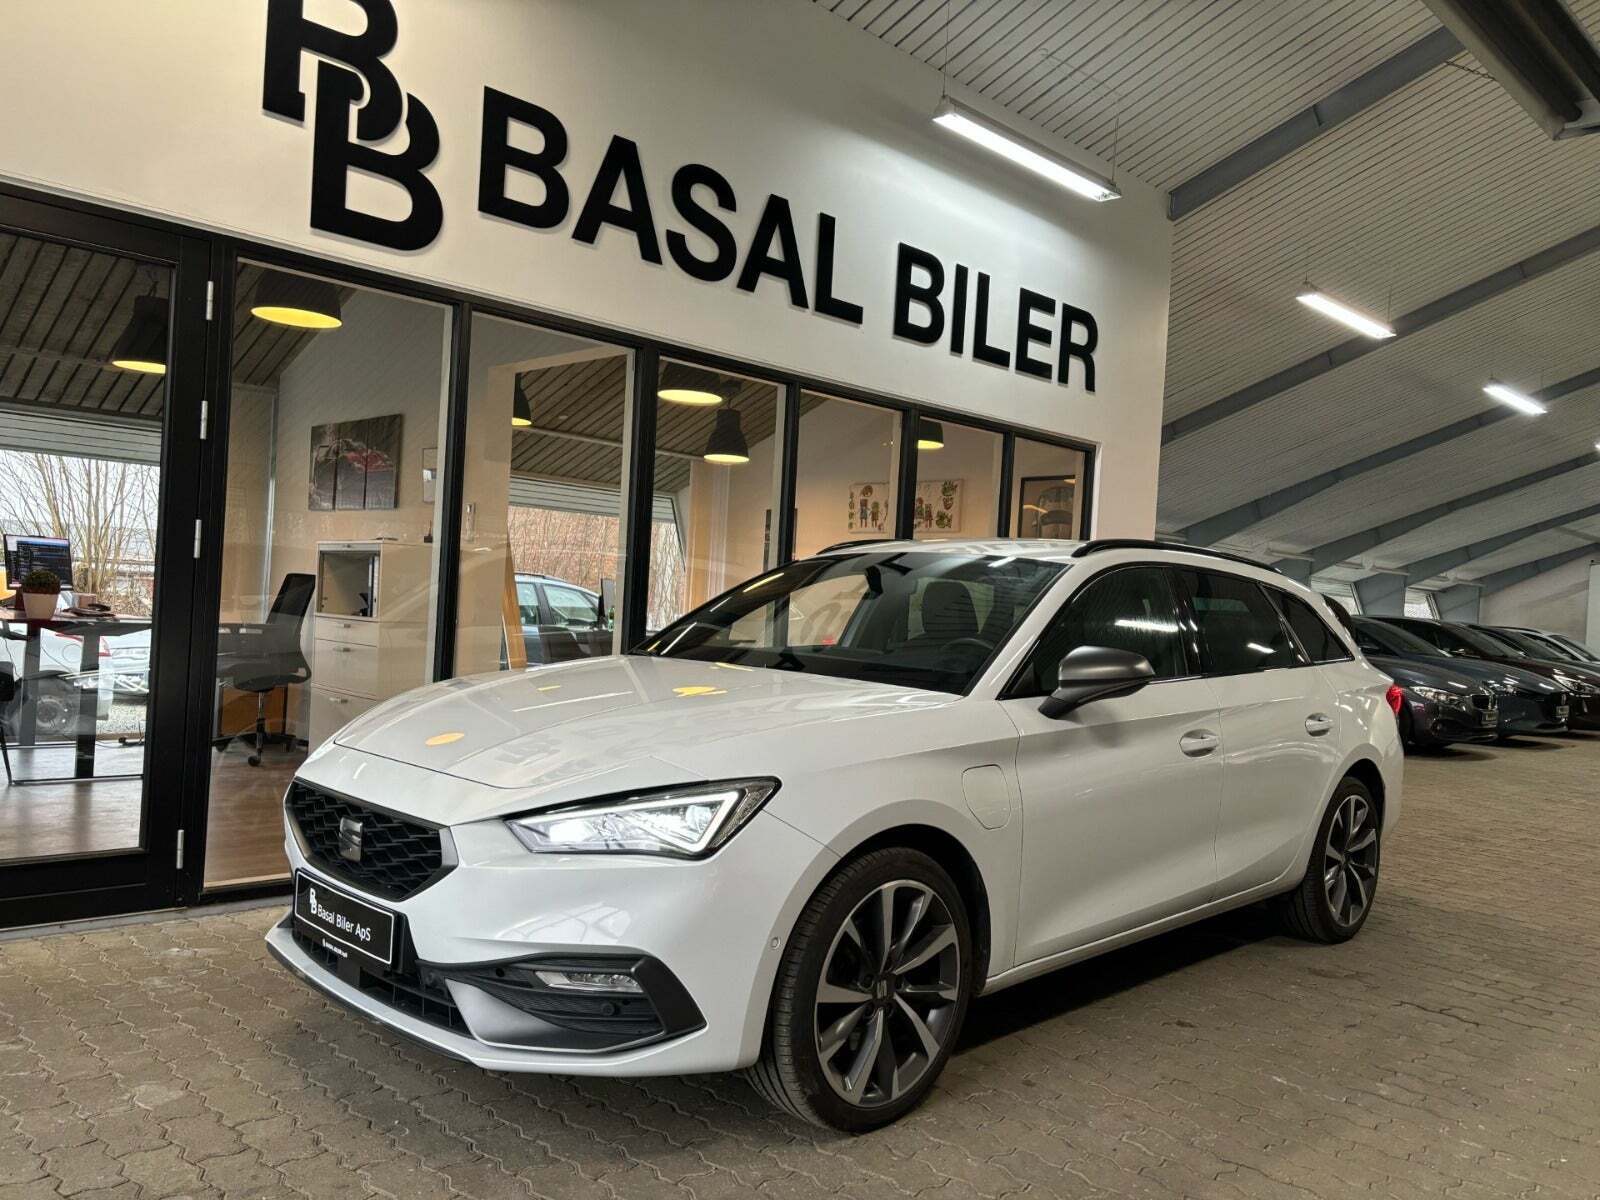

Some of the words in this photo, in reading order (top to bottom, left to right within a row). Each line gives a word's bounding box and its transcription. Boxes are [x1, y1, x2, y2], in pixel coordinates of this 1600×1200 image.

[478, 86, 864, 325] BASAL
[893, 242, 1099, 393] BILER
[317, 904, 334, 925] Basal
[336, 914, 354, 933] Biler
[355, 923, 371, 942] ApS
